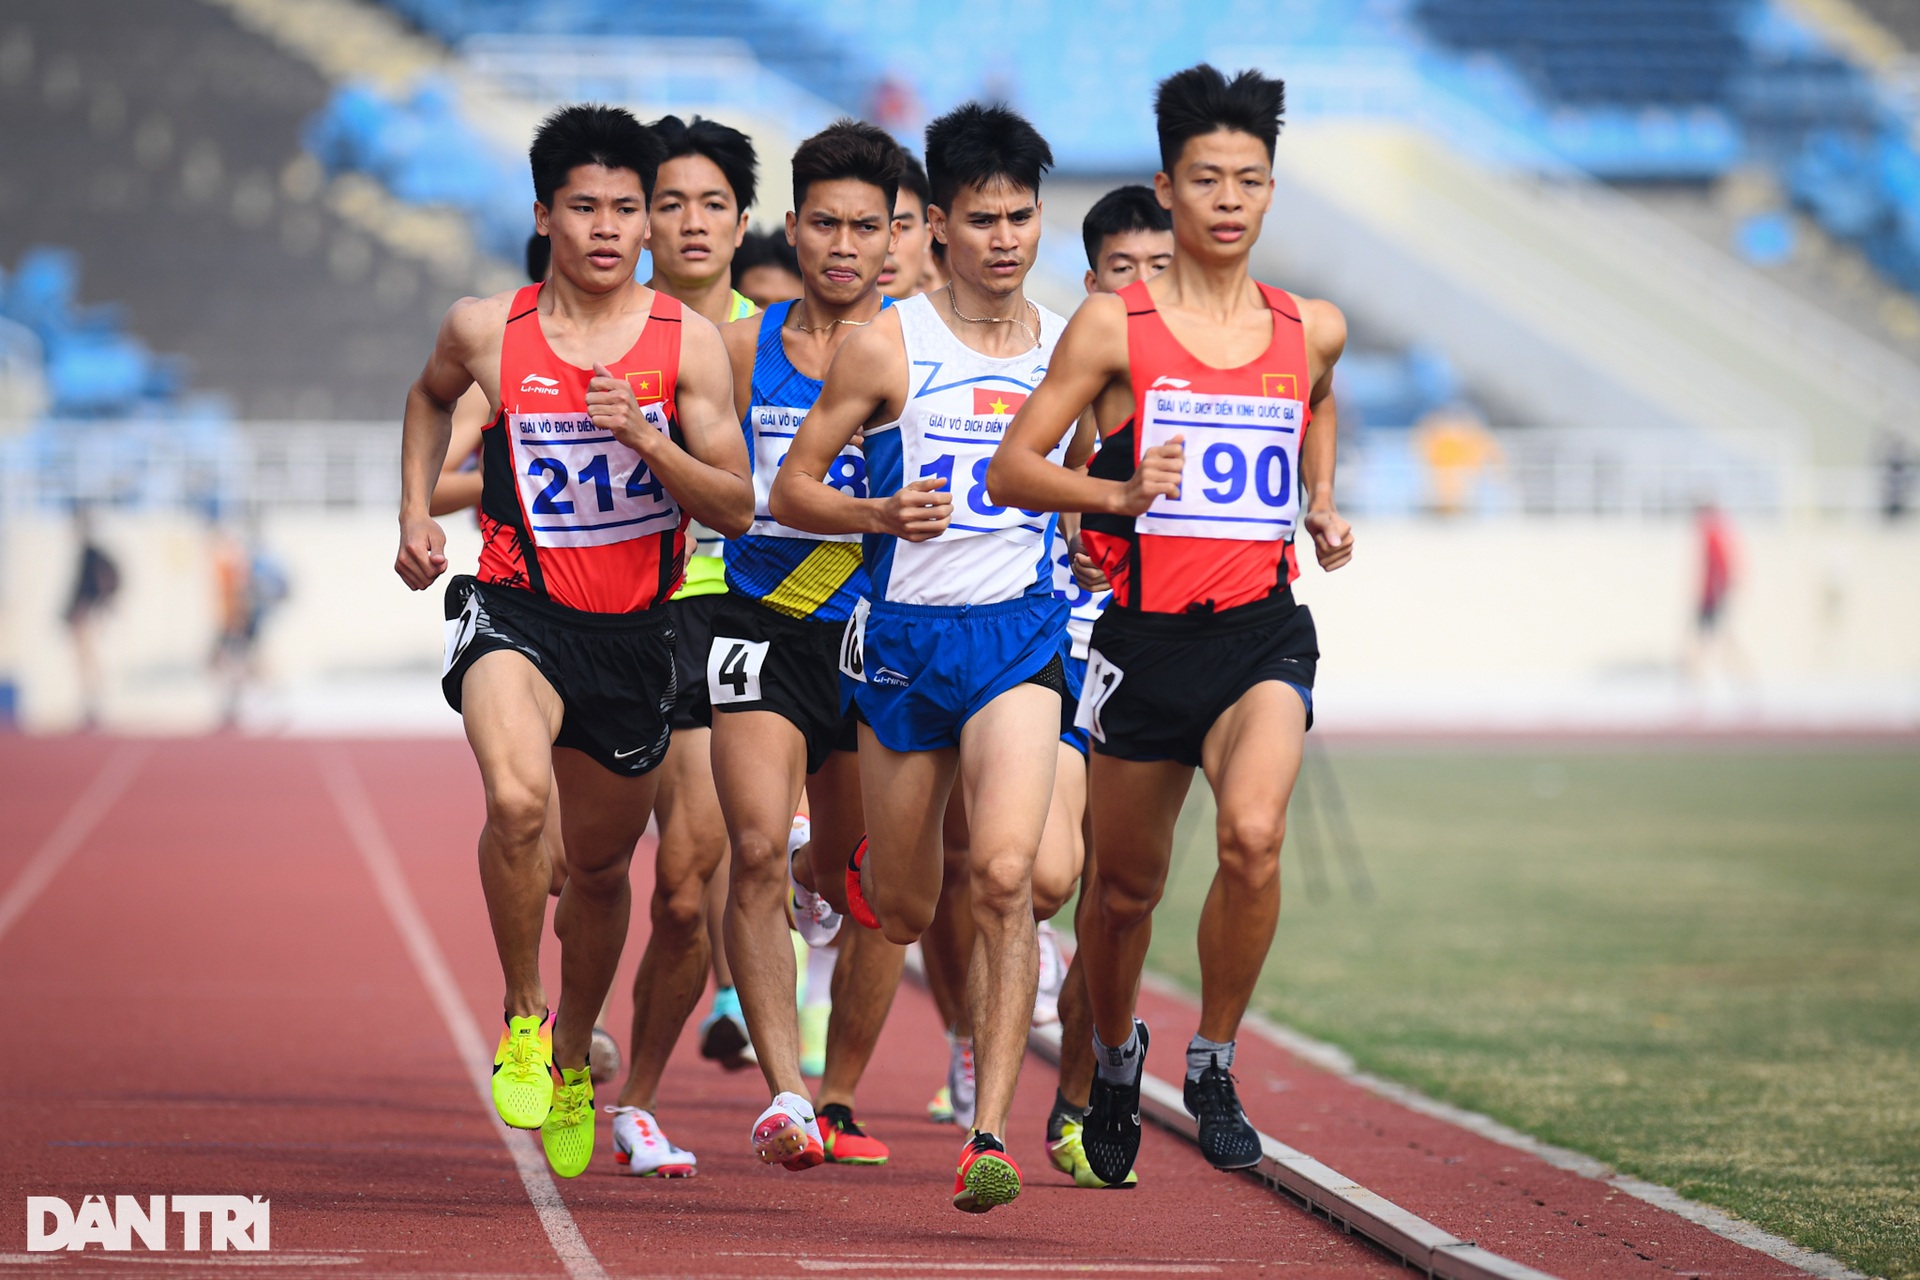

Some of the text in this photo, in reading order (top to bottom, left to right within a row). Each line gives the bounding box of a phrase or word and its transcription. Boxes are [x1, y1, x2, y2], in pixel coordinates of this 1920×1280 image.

[520, 385, 559, 396] LI-NING
[538, 419, 551, 433] VÔ
[645, 411, 659, 424] GIA
[778, 412, 790, 426] VÔ
[527, 454, 666, 515] 214
[919, 453, 1044, 517] 18
[1165, 440, 1290, 507] 90
[718, 643, 749, 696] 4
